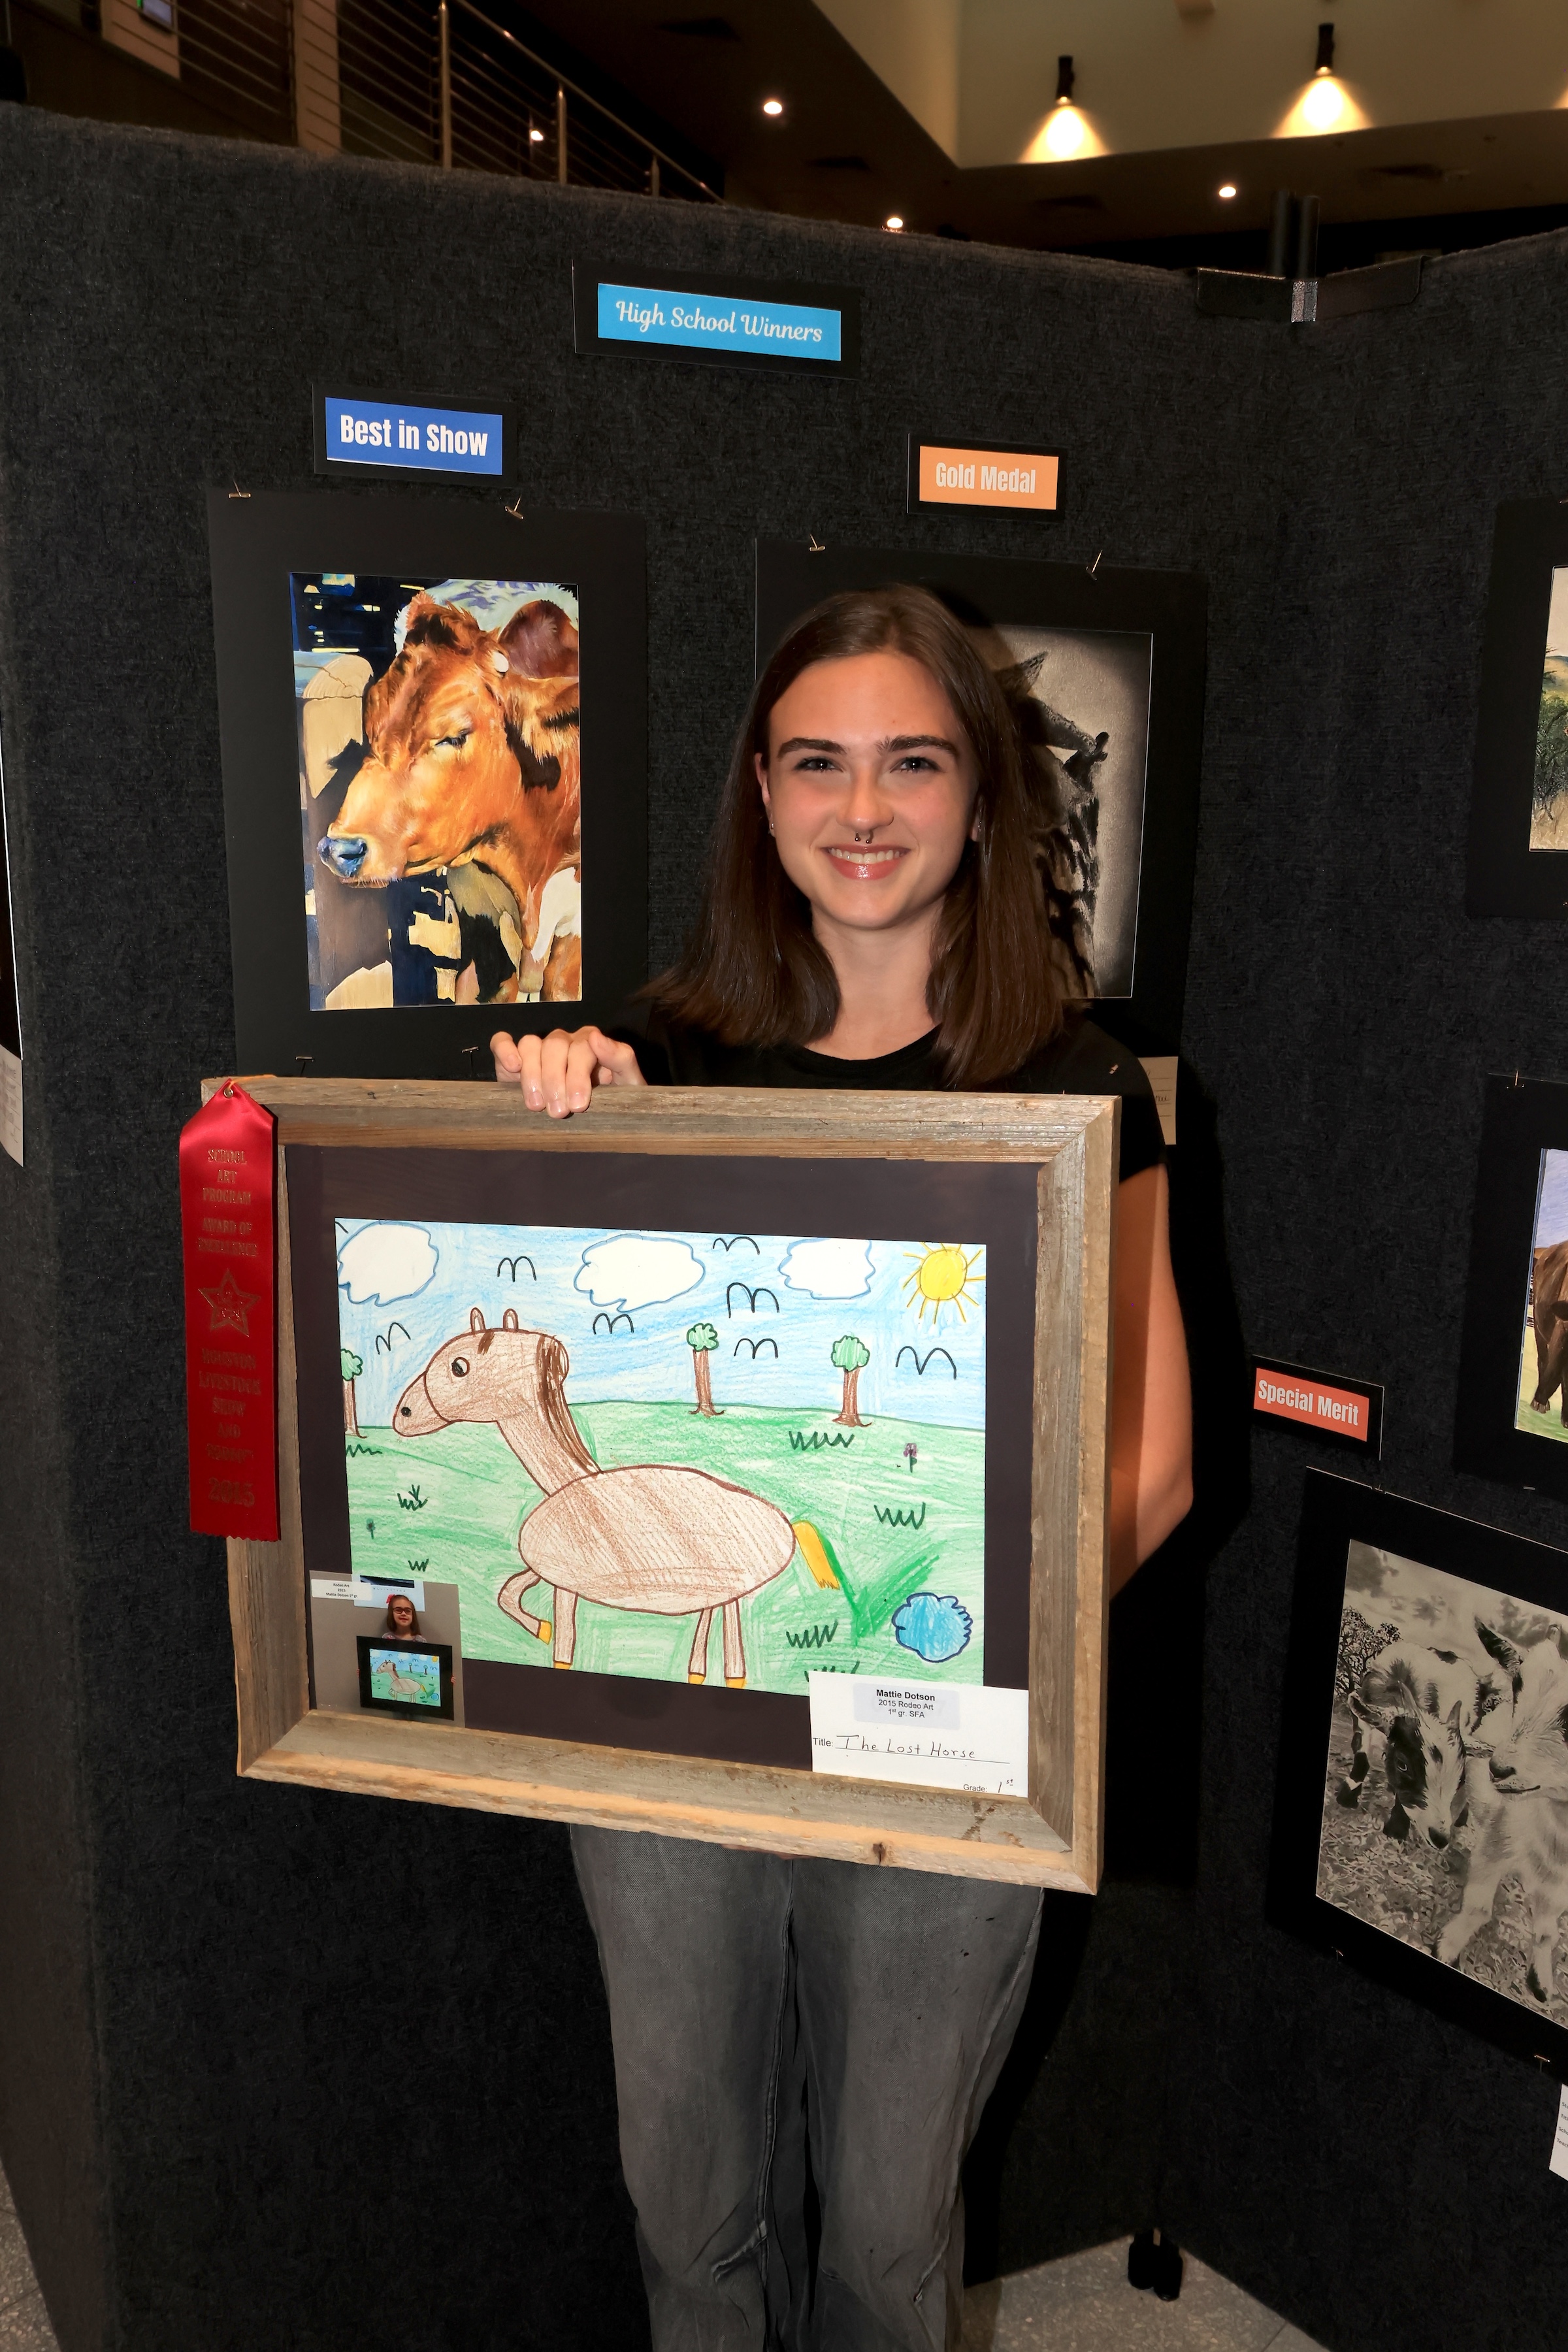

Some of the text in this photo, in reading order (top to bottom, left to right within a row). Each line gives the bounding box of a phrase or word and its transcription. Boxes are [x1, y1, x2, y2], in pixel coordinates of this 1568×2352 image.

[615, 301, 823, 342] High School Winners
[340, 414, 488, 456] Best in Show
[936, 462, 1036, 493] Gold Medal
[208, 1149, 247, 1164] SCHOOL
[217, 1170, 237, 1183] ART
[203, 1188, 251, 1205] PROGRAM
[1258, 1379, 1359, 1426] Special Merit
[208, 1477, 255, 1508] 2015
[876, 1690, 936, 1701] Mattie Dotson
[898, 1701, 921, 1709] Rodeo
[813, 1737, 834, 1748] Title:
[836, 1735, 975, 1758] The Lost Horse
[963, 1784, 988, 1793] Grade:
